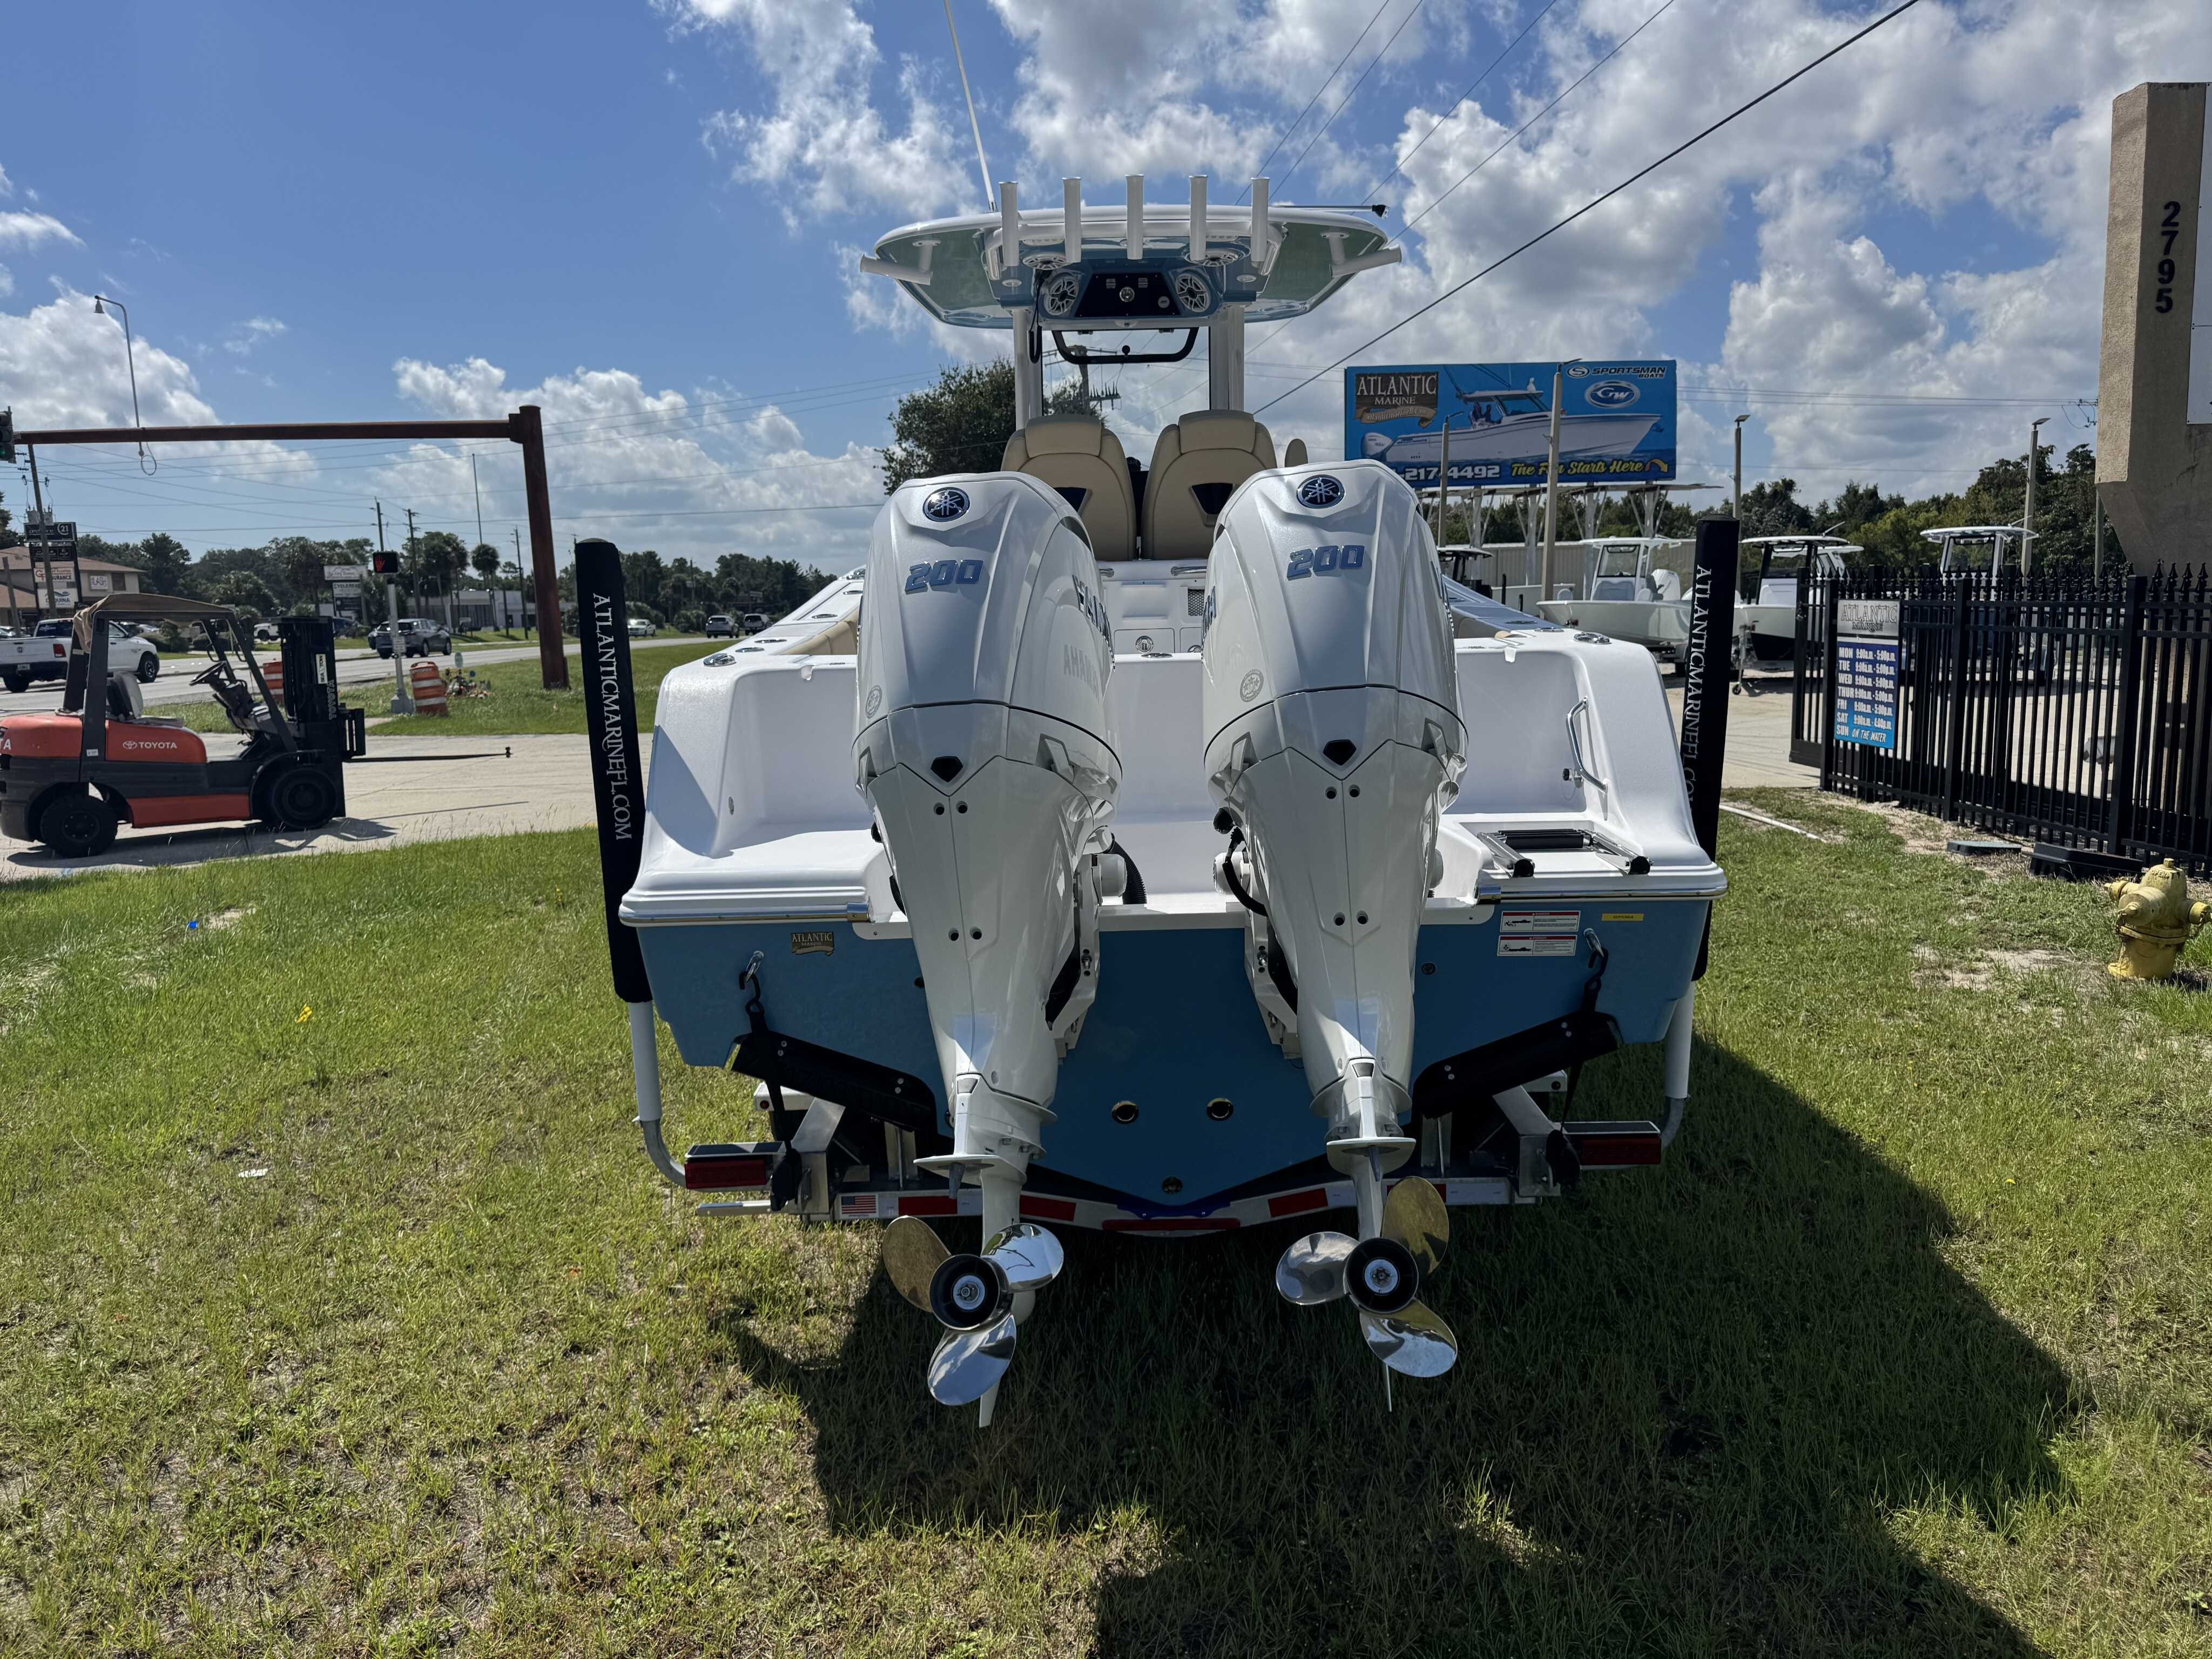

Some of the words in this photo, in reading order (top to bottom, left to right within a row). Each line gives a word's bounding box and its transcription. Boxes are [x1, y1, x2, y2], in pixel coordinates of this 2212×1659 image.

[2155, 201, 2181, 313] 2795
[1592, 367, 1666, 375] SPORTSMAN
[1357, 374, 1437, 396] ATLANTIC
[1374, 396, 1417, 406] MARINE
[1539, 463, 1564, 475] Fn
[1567, 461, 1607, 475] Starts
[1609, 461, 1643, 473] Here
[1286, 544, 1365, 581] 200
[905, 559, 984, 595] 200
[1841, 604, 1898, 624] ATLANTIC
[1852, 622, 1884, 632] MARINE
[1839, 648, 1853, 659] MON
[1838, 660, 1850, 671] TUE
[1838, 673, 1852, 684] WED
[1682, 564, 1711, 812] ATLANTICMARINEFL.CO
[1838, 686, 1854, 698] THUR
[327, 679, 337, 720] TOYOTA
[1837, 699, 1847, 710] FRI
[593, 593, 632, 841] ATLANTICMARINEFL.COM
[1837, 712, 1849, 723] SAT
[1836, 725, 1849, 736] SUN
[1852, 729, 1860, 738] ON
[1861, 730, 1870, 740] THE
[1870, 731, 1887, 743] WATER
[792, 932, 833, 942] ATLANTIC
